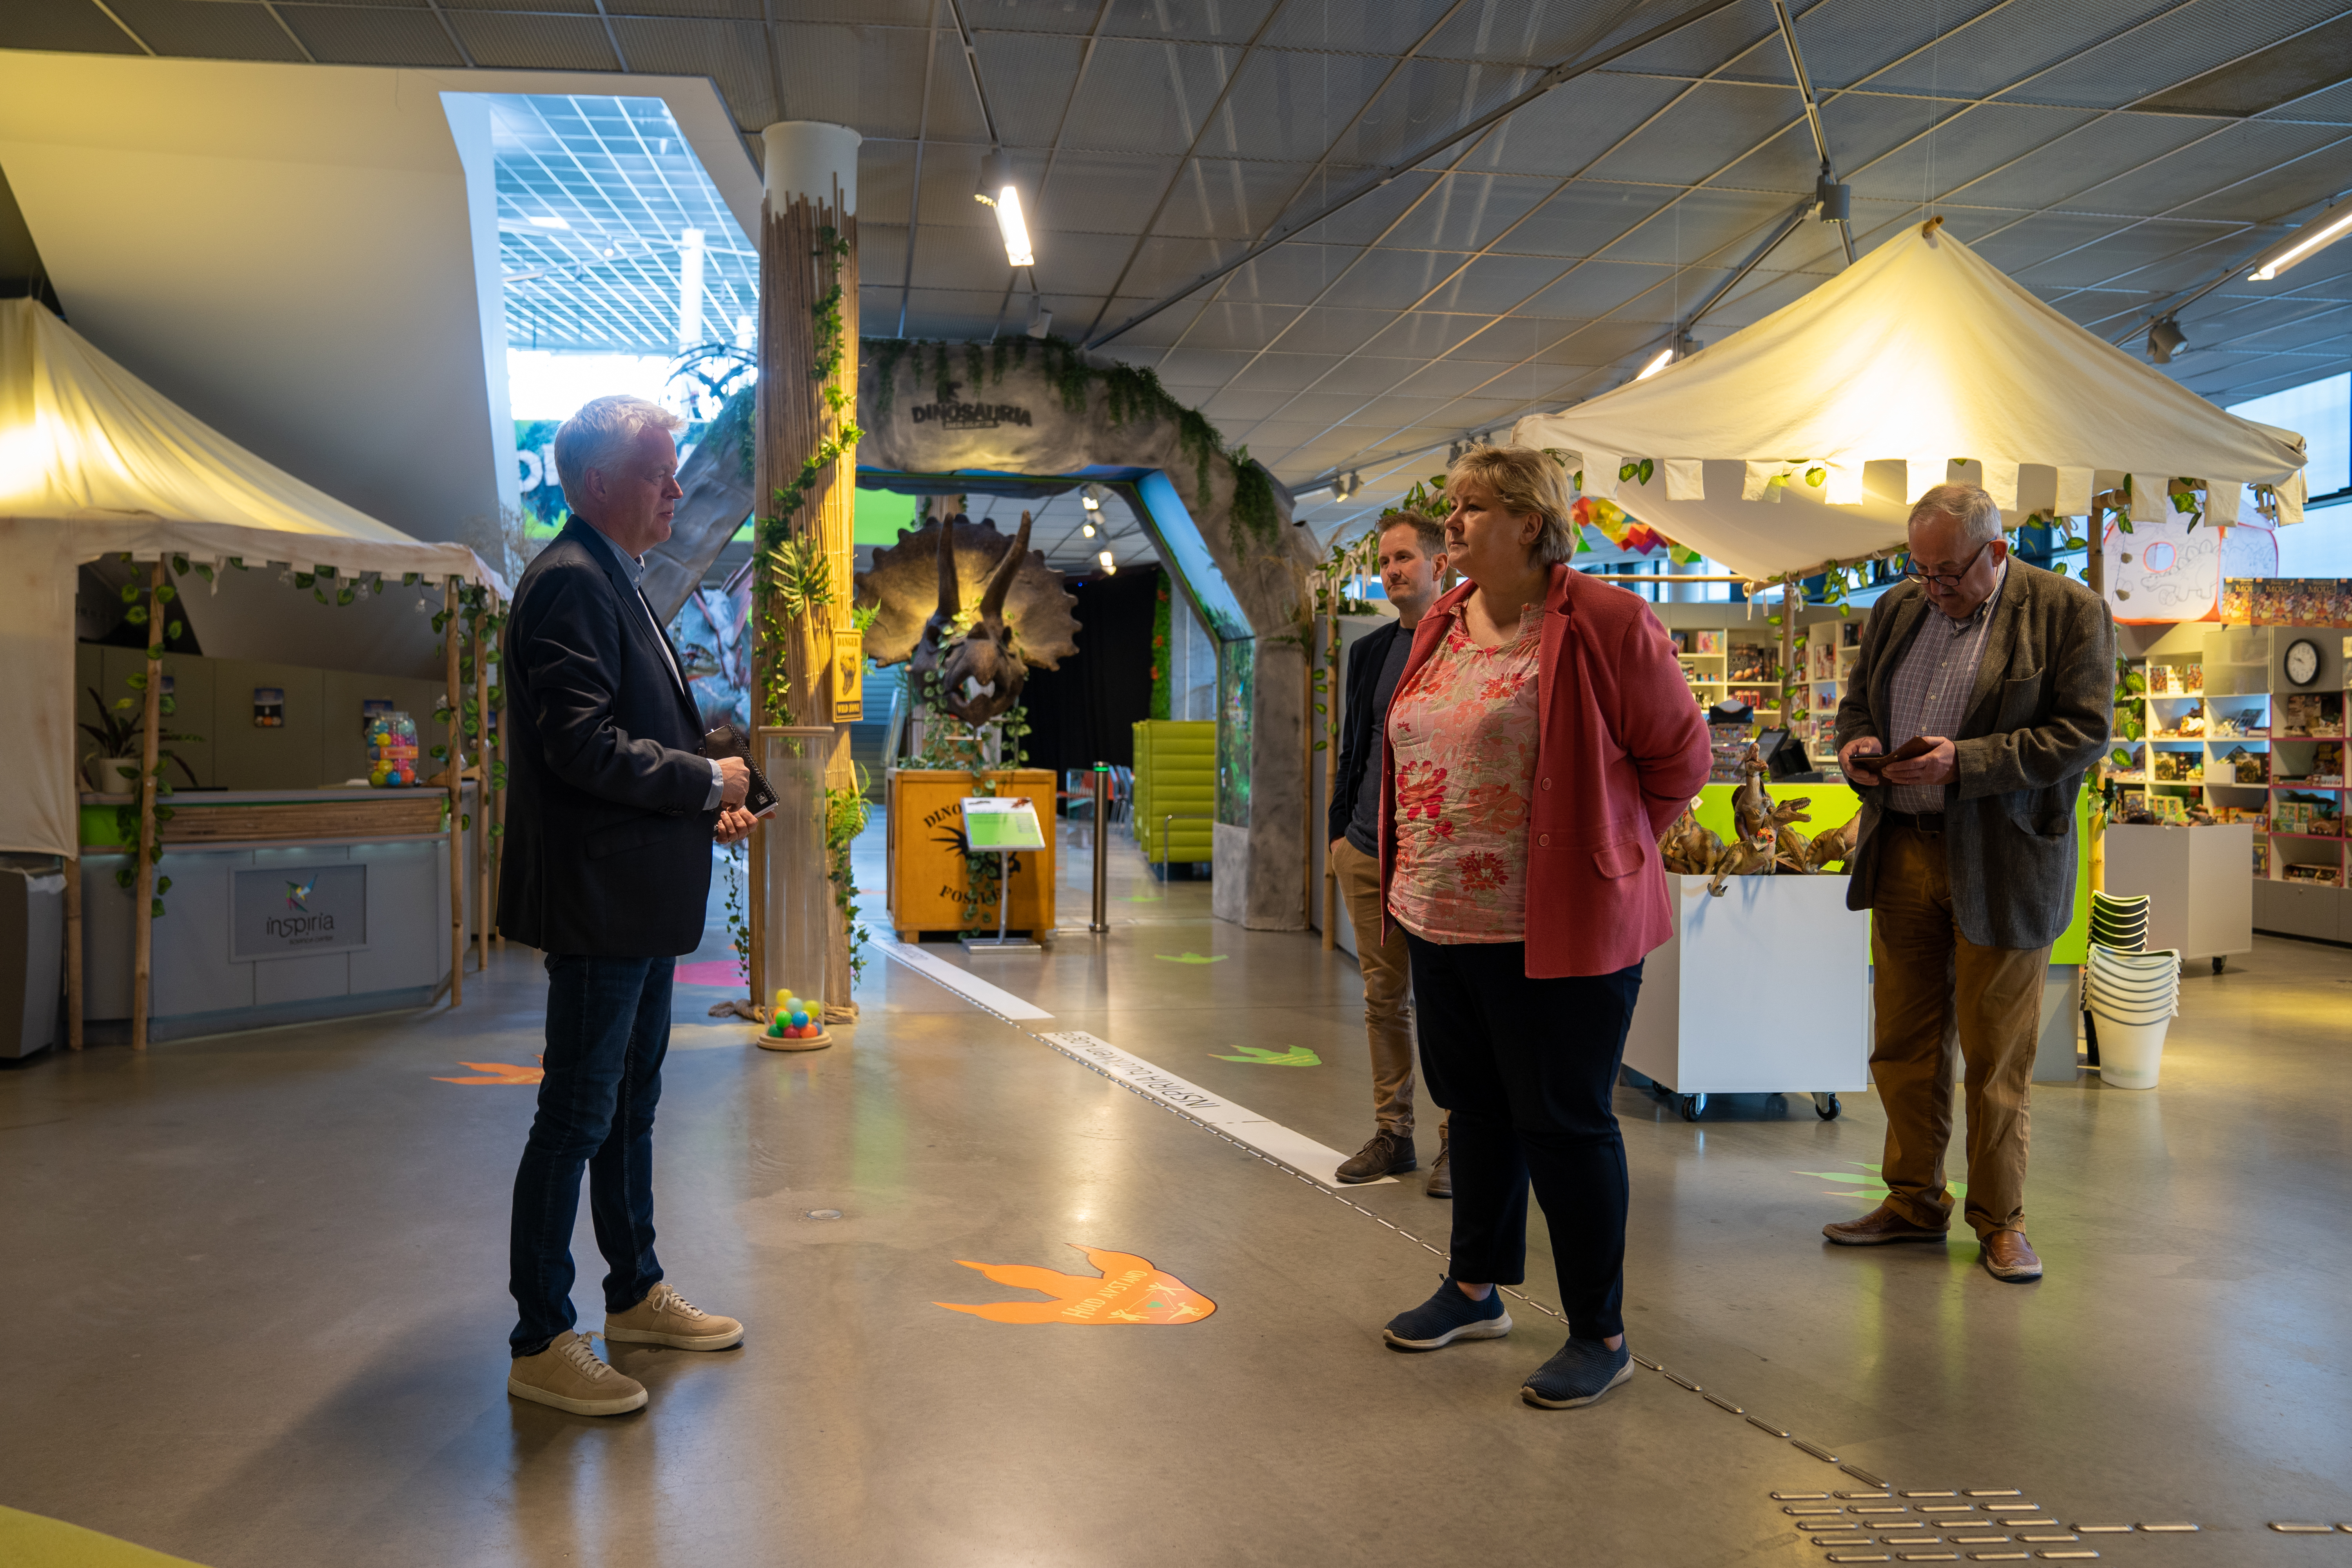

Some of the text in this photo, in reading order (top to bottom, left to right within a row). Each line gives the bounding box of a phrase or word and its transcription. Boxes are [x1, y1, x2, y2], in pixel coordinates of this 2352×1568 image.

[912, 402, 1032, 427] DINOSAURIA
[837, 637, 858, 647] DANGER
[837, 703, 860, 714] WILD ZONE
[924, 802, 962, 828] DINO
[267, 913, 334, 938] inspiria
[1086, 1047, 1153, 1075] butikken
[1135, 1075, 1221, 1109] INSPIRIA
[1060, 1270, 1148, 1319] HOLD AVSTAND
